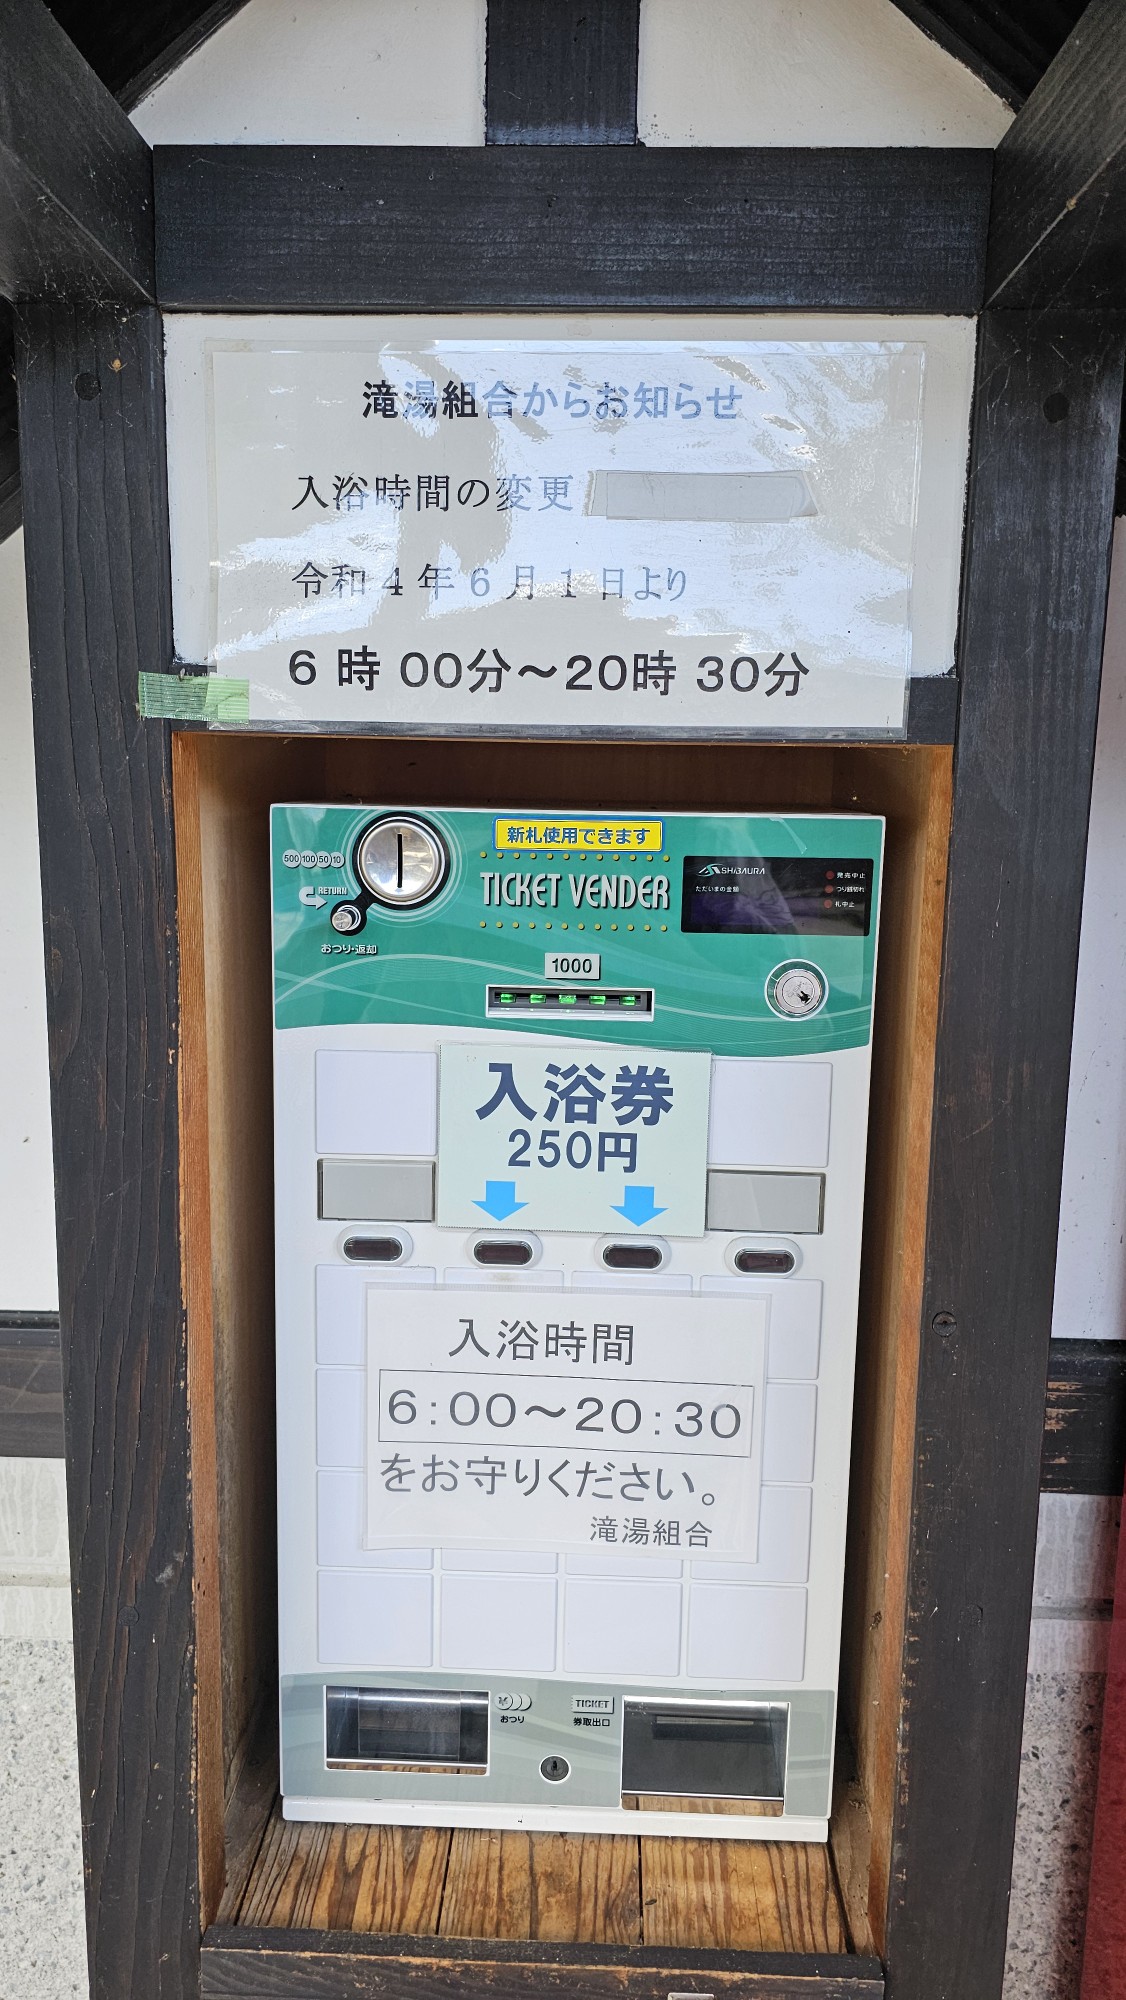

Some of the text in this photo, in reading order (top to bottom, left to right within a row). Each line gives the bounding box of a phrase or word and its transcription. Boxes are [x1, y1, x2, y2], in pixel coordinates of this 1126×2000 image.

[362, 380, 743, 420] 滝湯組合からお知らせ
[292, 473, 573, 513] 入浴時間の変更
[507, 826, 651, 845] 新札使用できます
[283, 853, 342, 865] 500 100 50 10
[721, 867, 766, 875] SHIBAURA
[318, 886, 348, 896] RETURN
[480, 872, 670, 909] TICKET VENDER
[695, 885, 740, 893] ただいまの金額
[551, 957, 593, 974] 1000
[475, 1062, 674, 1126] 入浴券
[508, 1128, 638, 1173] 250円
[448, 1318, 635, 1366] 入浴時間
[380, 1452, 716, 1507] をお守りください。
[589, 1515, 713, 1548] 滝湯組合
[575, 1699, 610, 1709] TICKET
[500, 1715, 525, 1724] おつり
[573, 1717, 611, 1727] 券取出口
